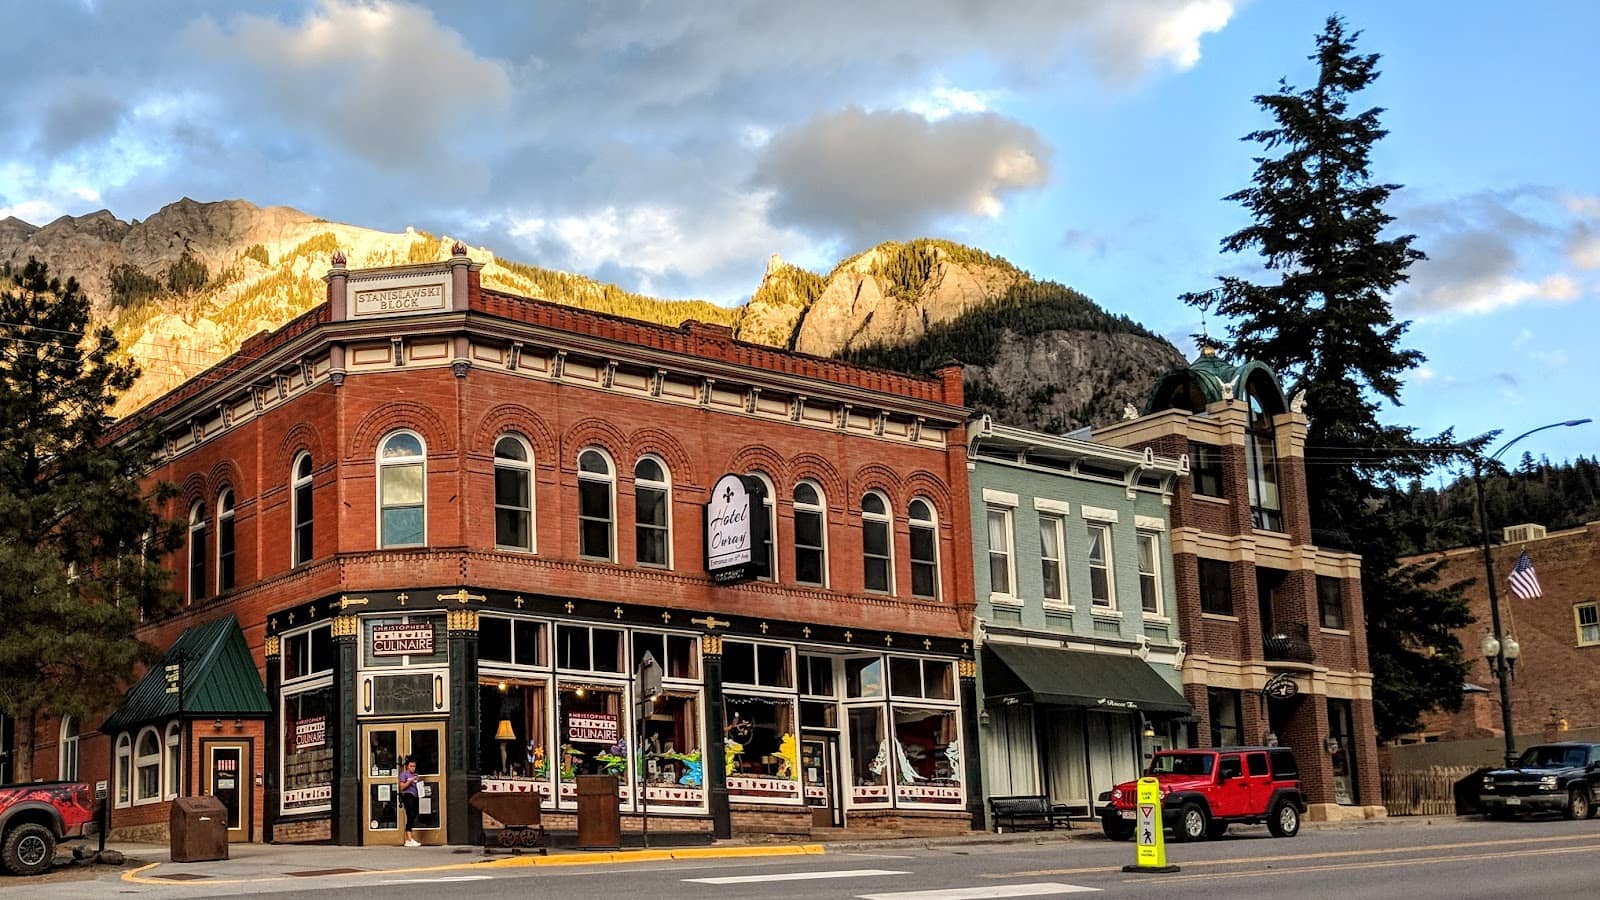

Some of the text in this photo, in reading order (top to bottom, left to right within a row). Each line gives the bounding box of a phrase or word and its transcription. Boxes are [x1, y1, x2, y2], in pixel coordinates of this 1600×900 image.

[358, 287, 440, 303] STANISLAWSKI
[380, 298, 419, 310] BLOCK
[711, 504, 748, 530] Hotel
[711, 531, 747, 550] Ouray
[374, 639, 433, 651] CULINAIRE
[296, 732, 325, 744] CULINAIRE
[569, 727, 617, 740] CULINAIRE
